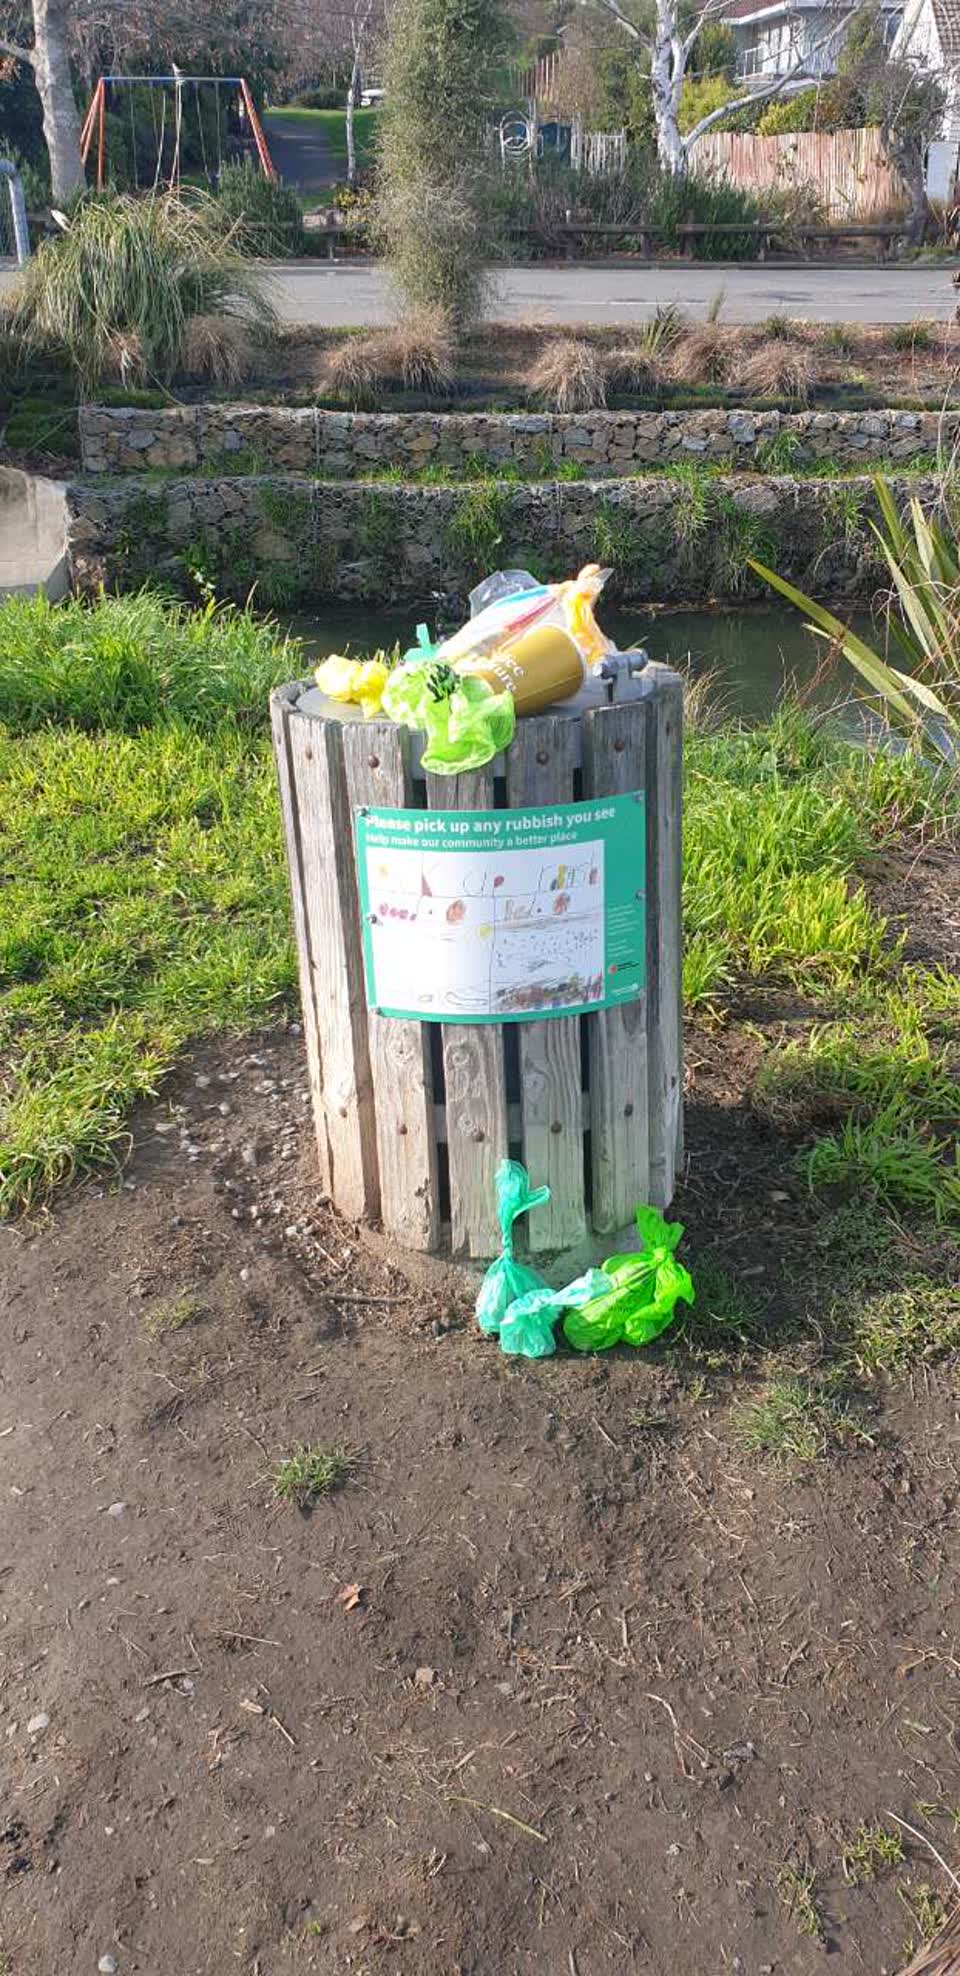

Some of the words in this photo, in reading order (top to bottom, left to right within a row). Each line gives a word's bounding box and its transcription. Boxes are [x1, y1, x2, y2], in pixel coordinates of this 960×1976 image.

[366, 815, 411, 831] Please
[415, 818, 446, 833] pick
[450, 823, 469, 834] up
[473, 820, 501, 835] any
[506, 814, 563, 830] rubbish
[566, 811, 592, 828] you
[594, 807, 616, 820] see
[391, 836, 419, 846] make
[421, 838, 439, 847] our
[442, 837, 503, 849] community
[506, 837, 513, 846] a
[516, 834, 546, 846] better
[550, 831, 577, 845] place
